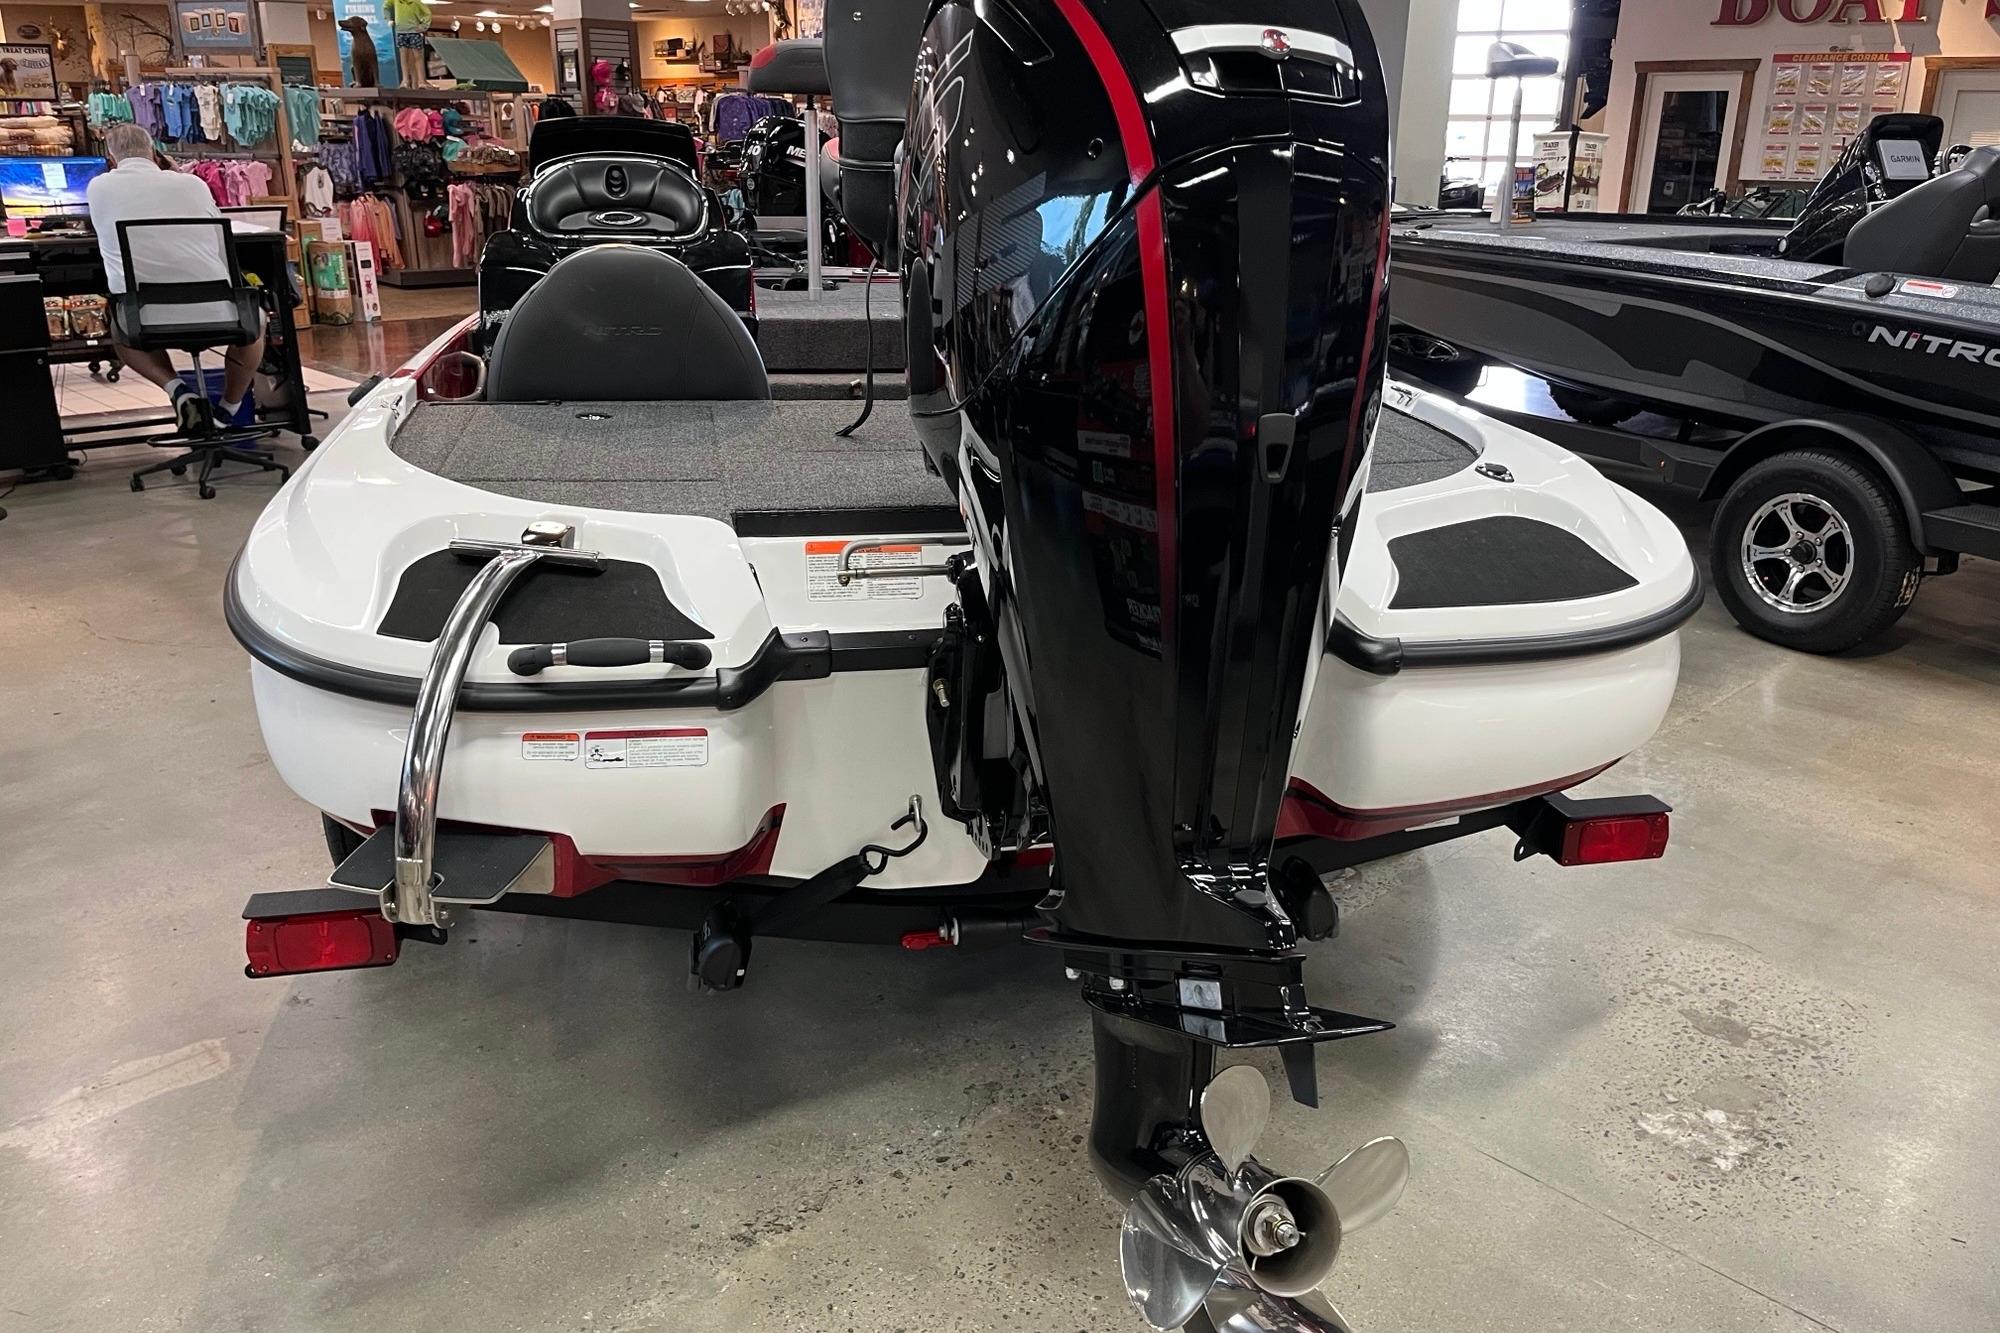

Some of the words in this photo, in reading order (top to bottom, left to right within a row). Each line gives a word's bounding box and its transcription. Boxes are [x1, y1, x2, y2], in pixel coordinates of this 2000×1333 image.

[1792, 53, 1848, 62] CLEARANCE
[1851, 53, 1890, 62] CORRAL
[1890, 155, 1921, 163] GARMIN
